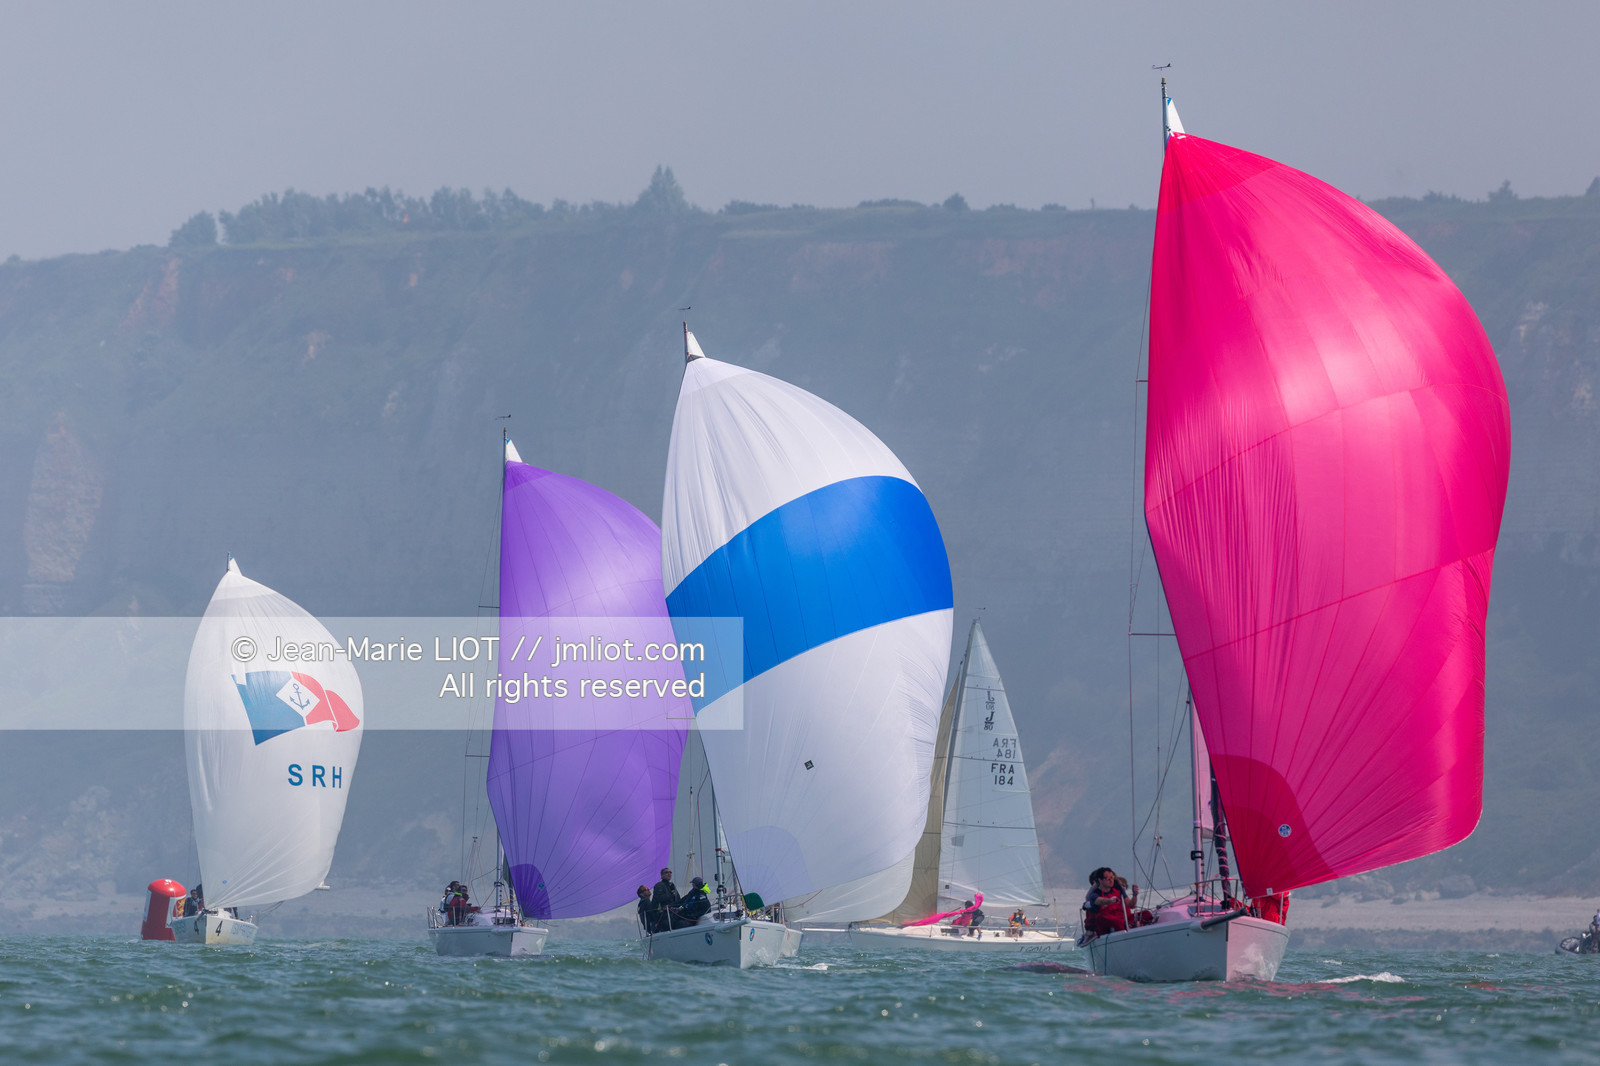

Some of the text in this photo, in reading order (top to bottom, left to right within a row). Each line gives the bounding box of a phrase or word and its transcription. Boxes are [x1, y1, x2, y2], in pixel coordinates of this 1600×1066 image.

[990, 763, 1015, 774] FRA
[994, 775, 1014, 786] 184
[215, 920, 224, 937] 4
